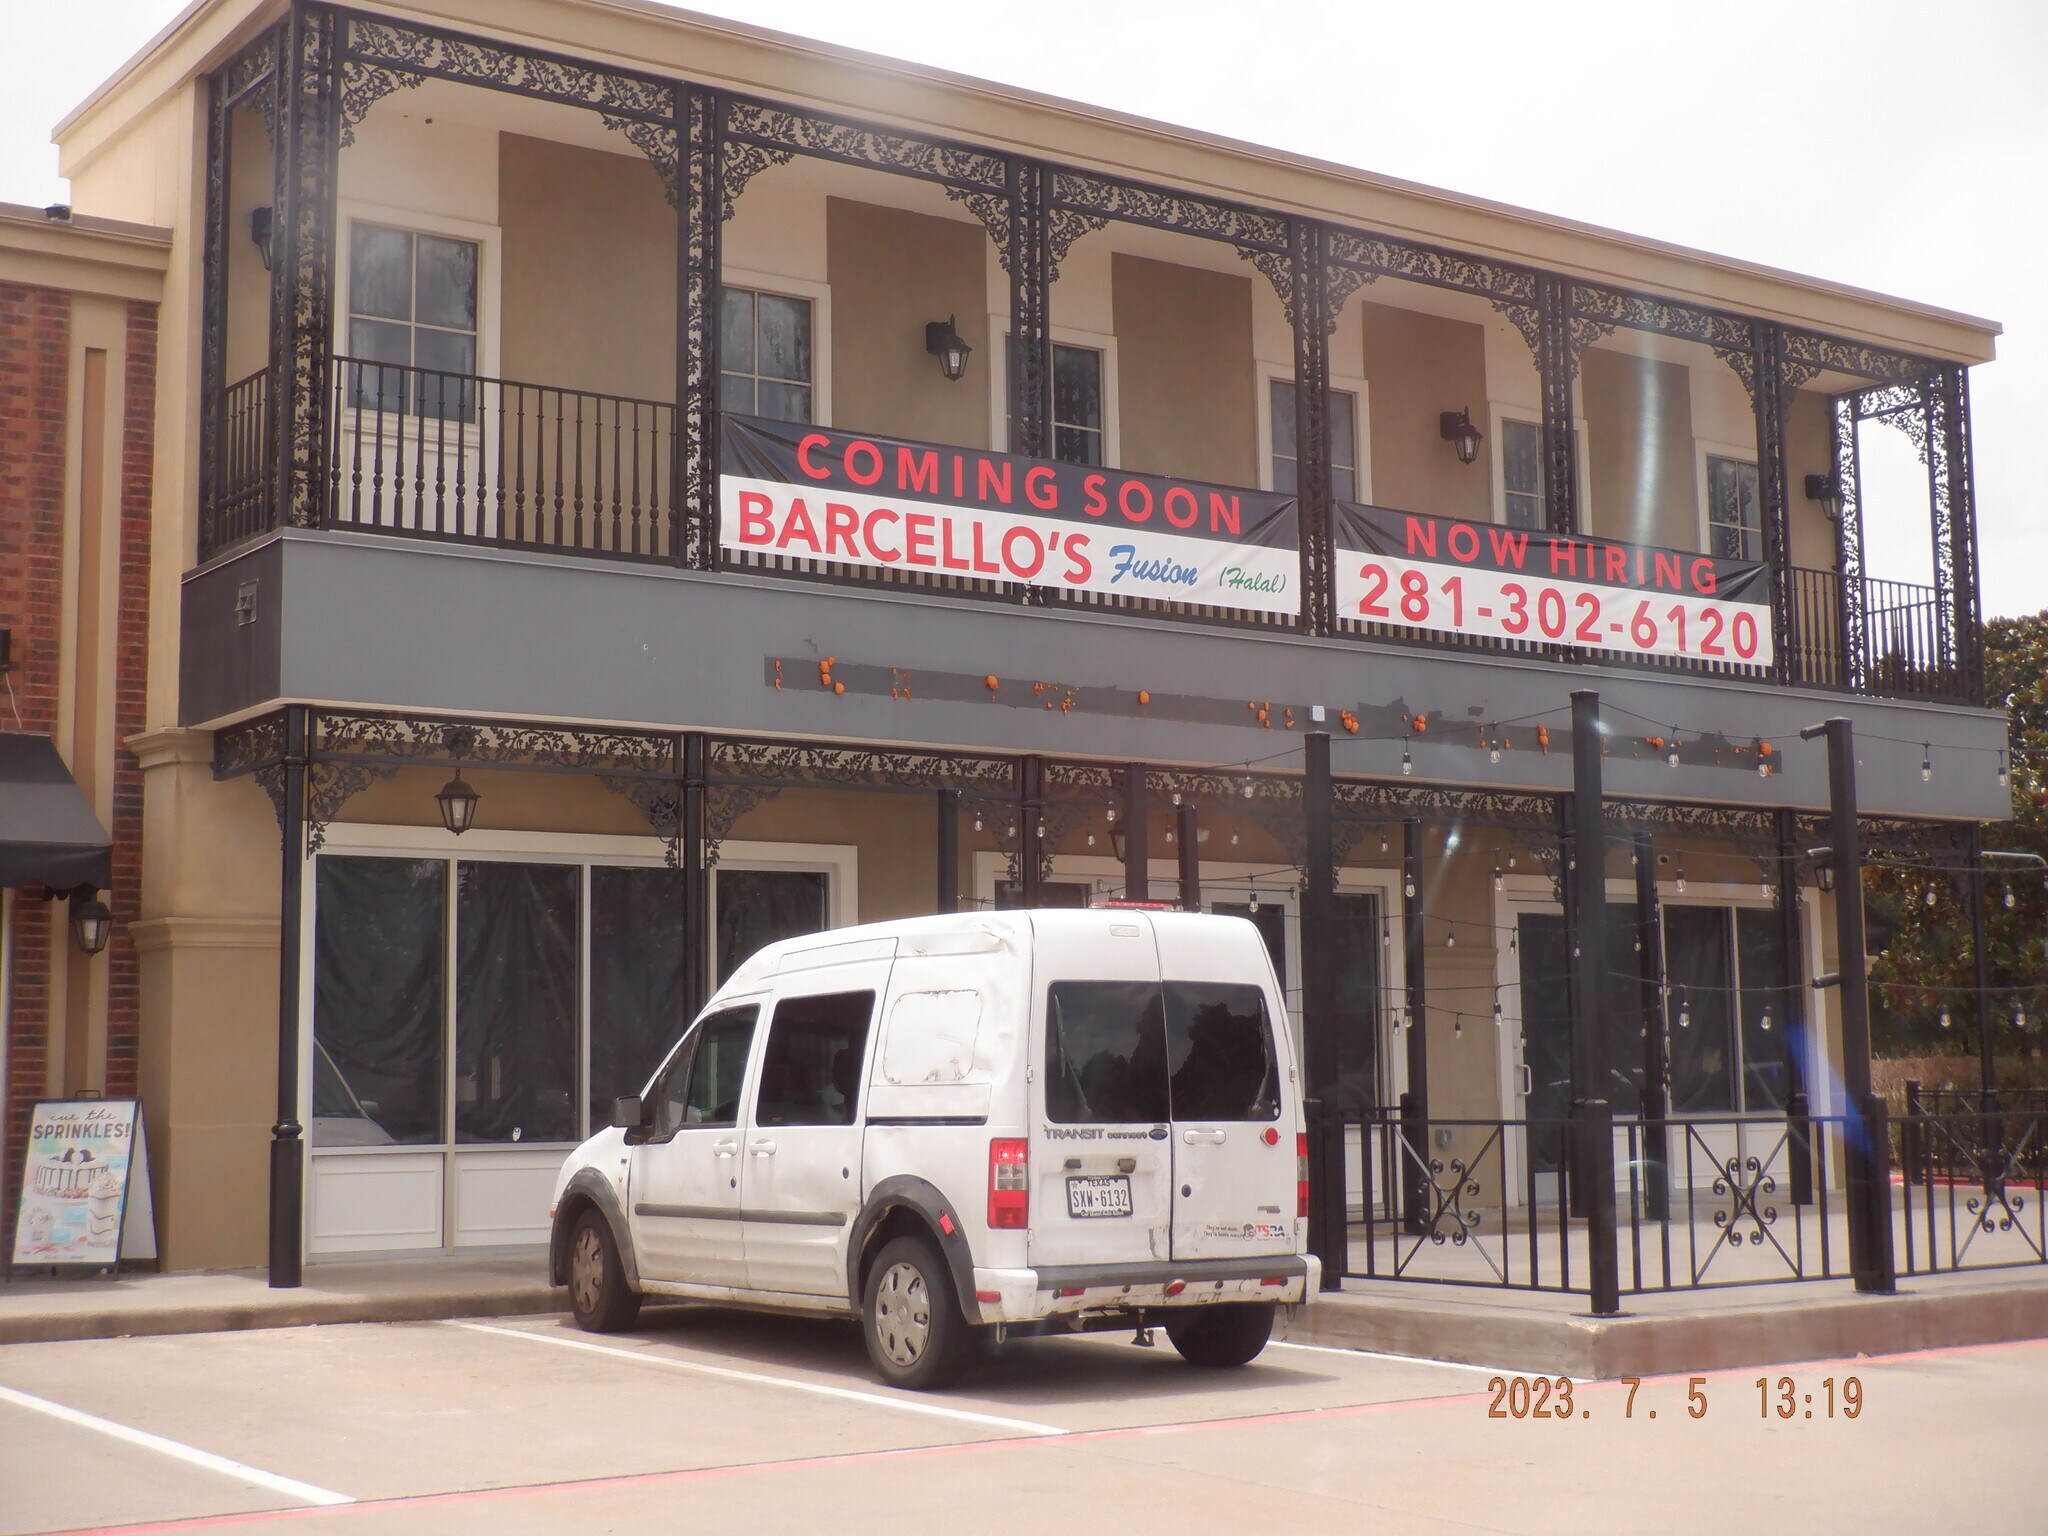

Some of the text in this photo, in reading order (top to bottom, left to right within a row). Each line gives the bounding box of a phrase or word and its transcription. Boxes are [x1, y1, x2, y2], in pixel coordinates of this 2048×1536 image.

[796, 433, 1241, 535] COMING SOON
[738, 490, 1286, 593] BARCELLO'S Fusion (Halal)
[1405, 516, 1717, 595] NOW HIRING
[1359, 563, 1759, 659] 281-302-6120
[33, 1123, 131, 1140] SPRINKLES!
[85, 1108, 117, 1120] the
[1043, 1128, 1105, 1140] TRANSIT
[1087, 1179, 1111, 1187] TEXAS
